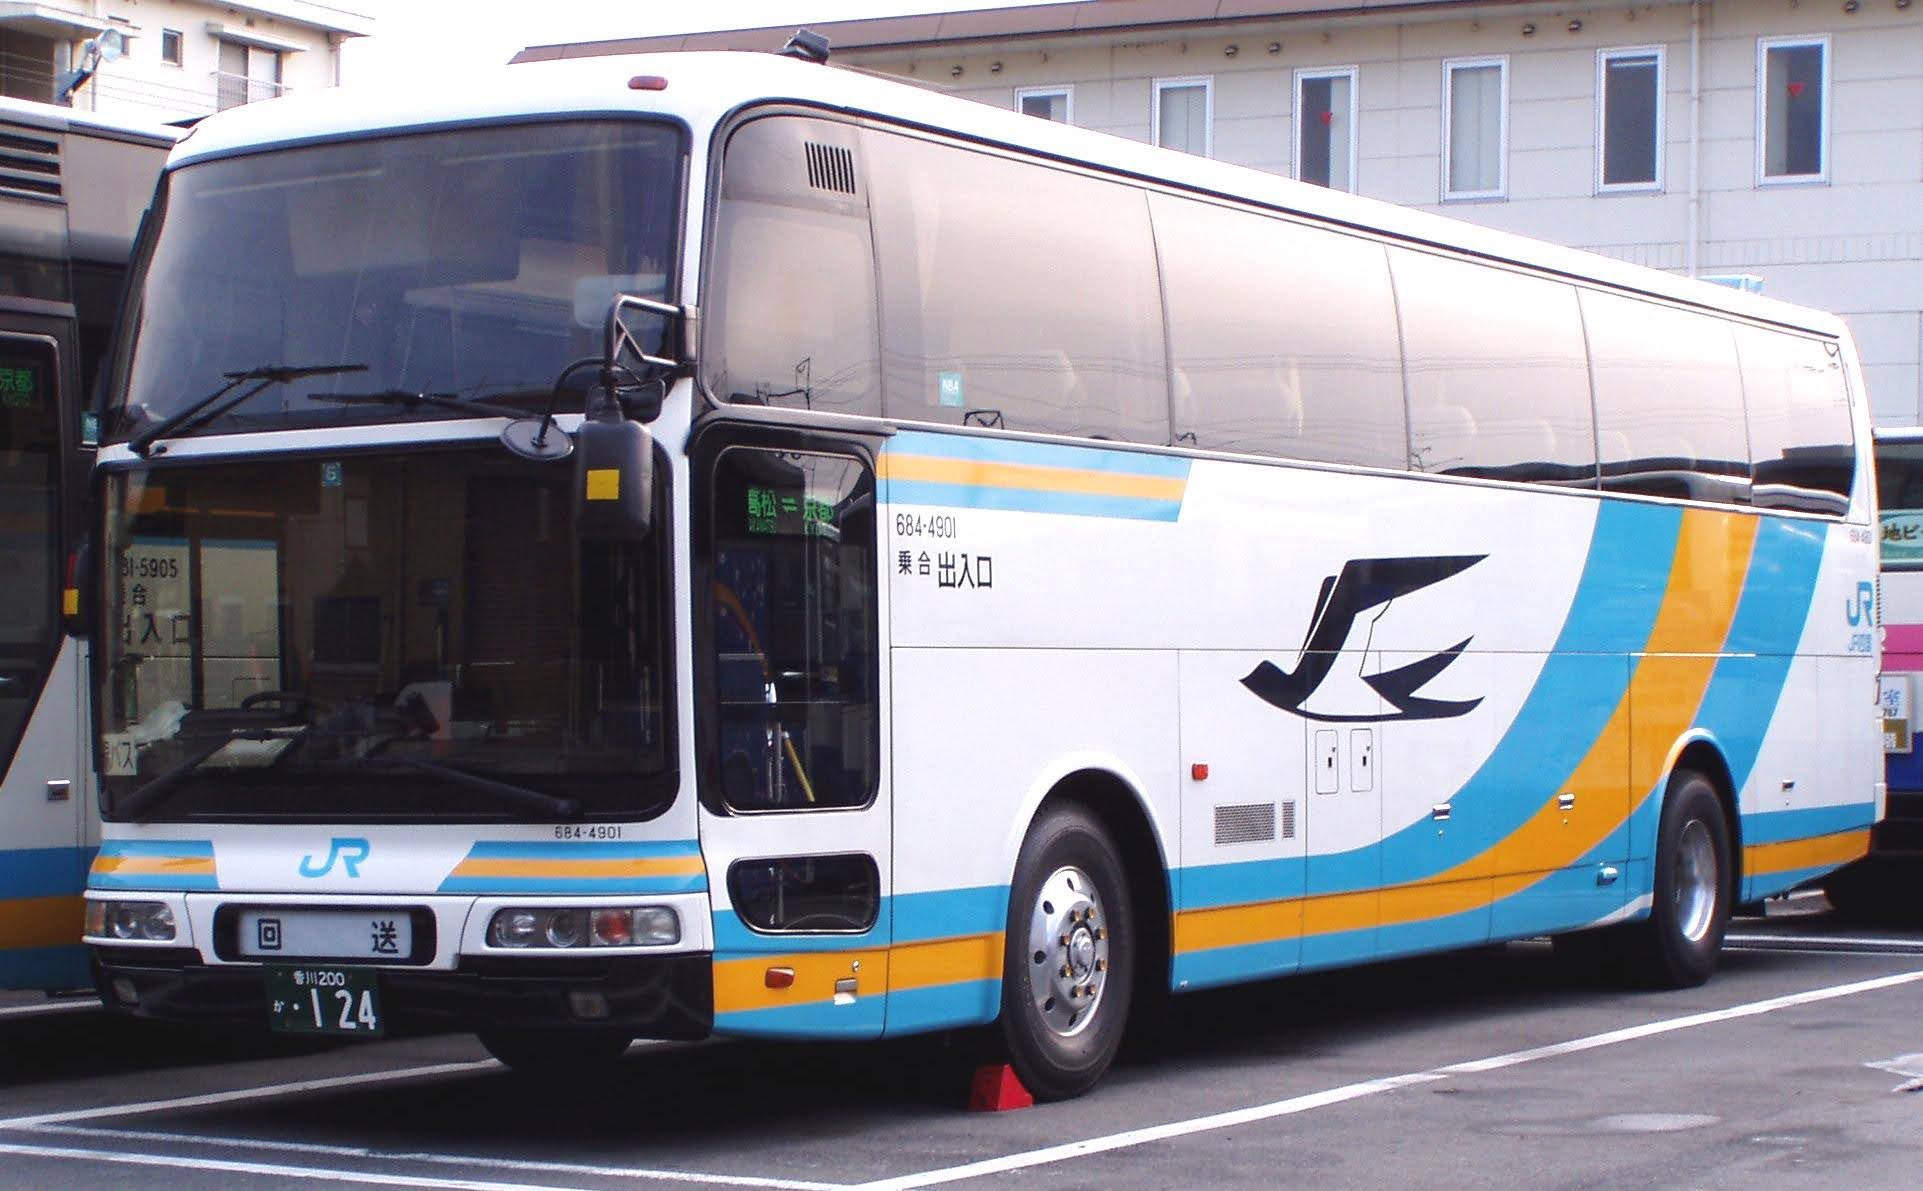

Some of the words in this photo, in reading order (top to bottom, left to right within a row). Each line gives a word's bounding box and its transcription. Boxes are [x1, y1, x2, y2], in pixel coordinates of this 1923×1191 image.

[898, 550, 931, 575] 乗合
[938, 551, 992, 588] 出入口
[1846, 581, 1873, 627] JR
[299, 837, 371, 879] JR
